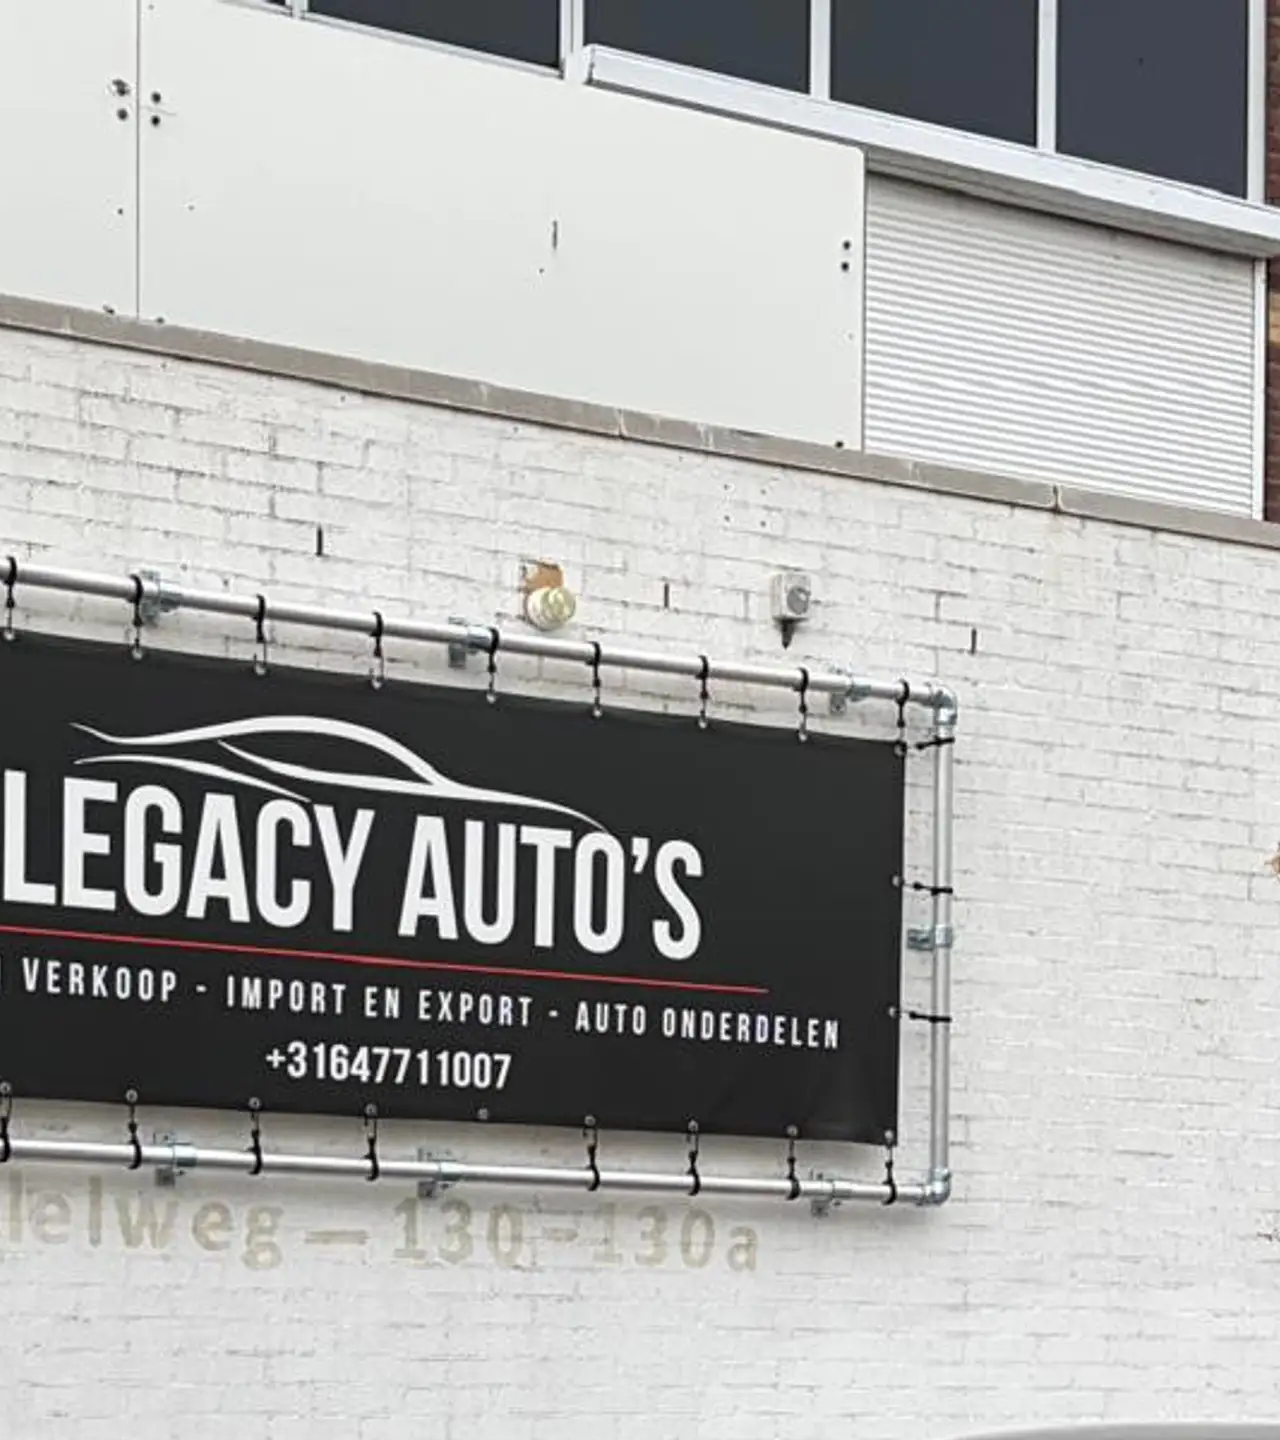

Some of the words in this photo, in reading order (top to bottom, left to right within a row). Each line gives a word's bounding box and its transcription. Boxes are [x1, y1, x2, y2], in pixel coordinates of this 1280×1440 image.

[3, 769, 375, 932] LEGACY
[398, 814, 703, 960] AUTO'S
[22, 957, 178, 1002] VERKOOP
[227, 974, 347, 1015] IMPORT
[364, 986, 401, 1020] EN
[419, 989, 533, 1027] EXPORT
[574, 1001, 648, 1036] AUTO
[662, 1007, 841, 1050] ONDERDELEN
[265, 1040, 512, 1090] +31647711007
